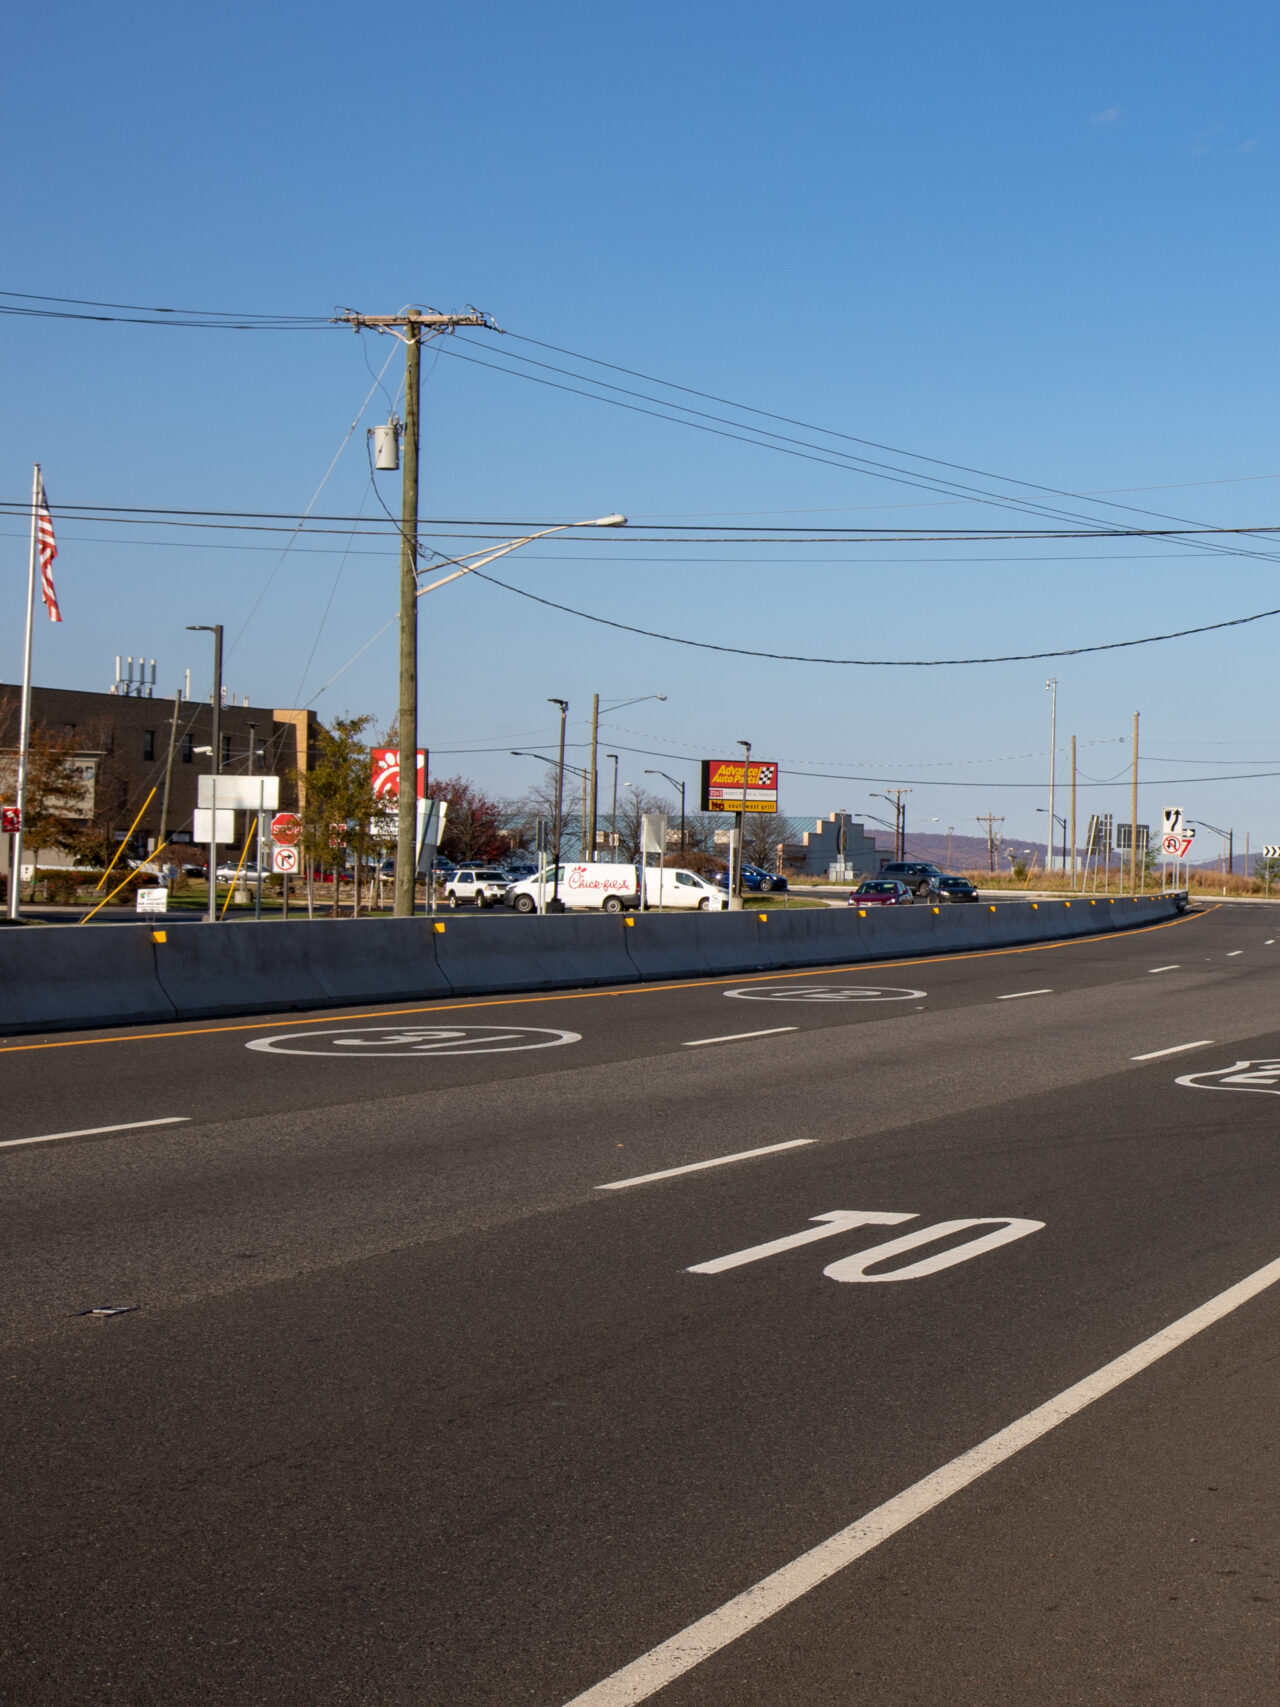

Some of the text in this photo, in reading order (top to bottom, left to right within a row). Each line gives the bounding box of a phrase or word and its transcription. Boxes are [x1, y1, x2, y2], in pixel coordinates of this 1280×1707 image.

[718, 765, 759, 776] Advance
[712, 774, 757, 784] Auto Pats
[770, 987, 882, 999] 12
[332, 1030, 526, 1050] 31
[685, 1209, 1047, 1283] TO
